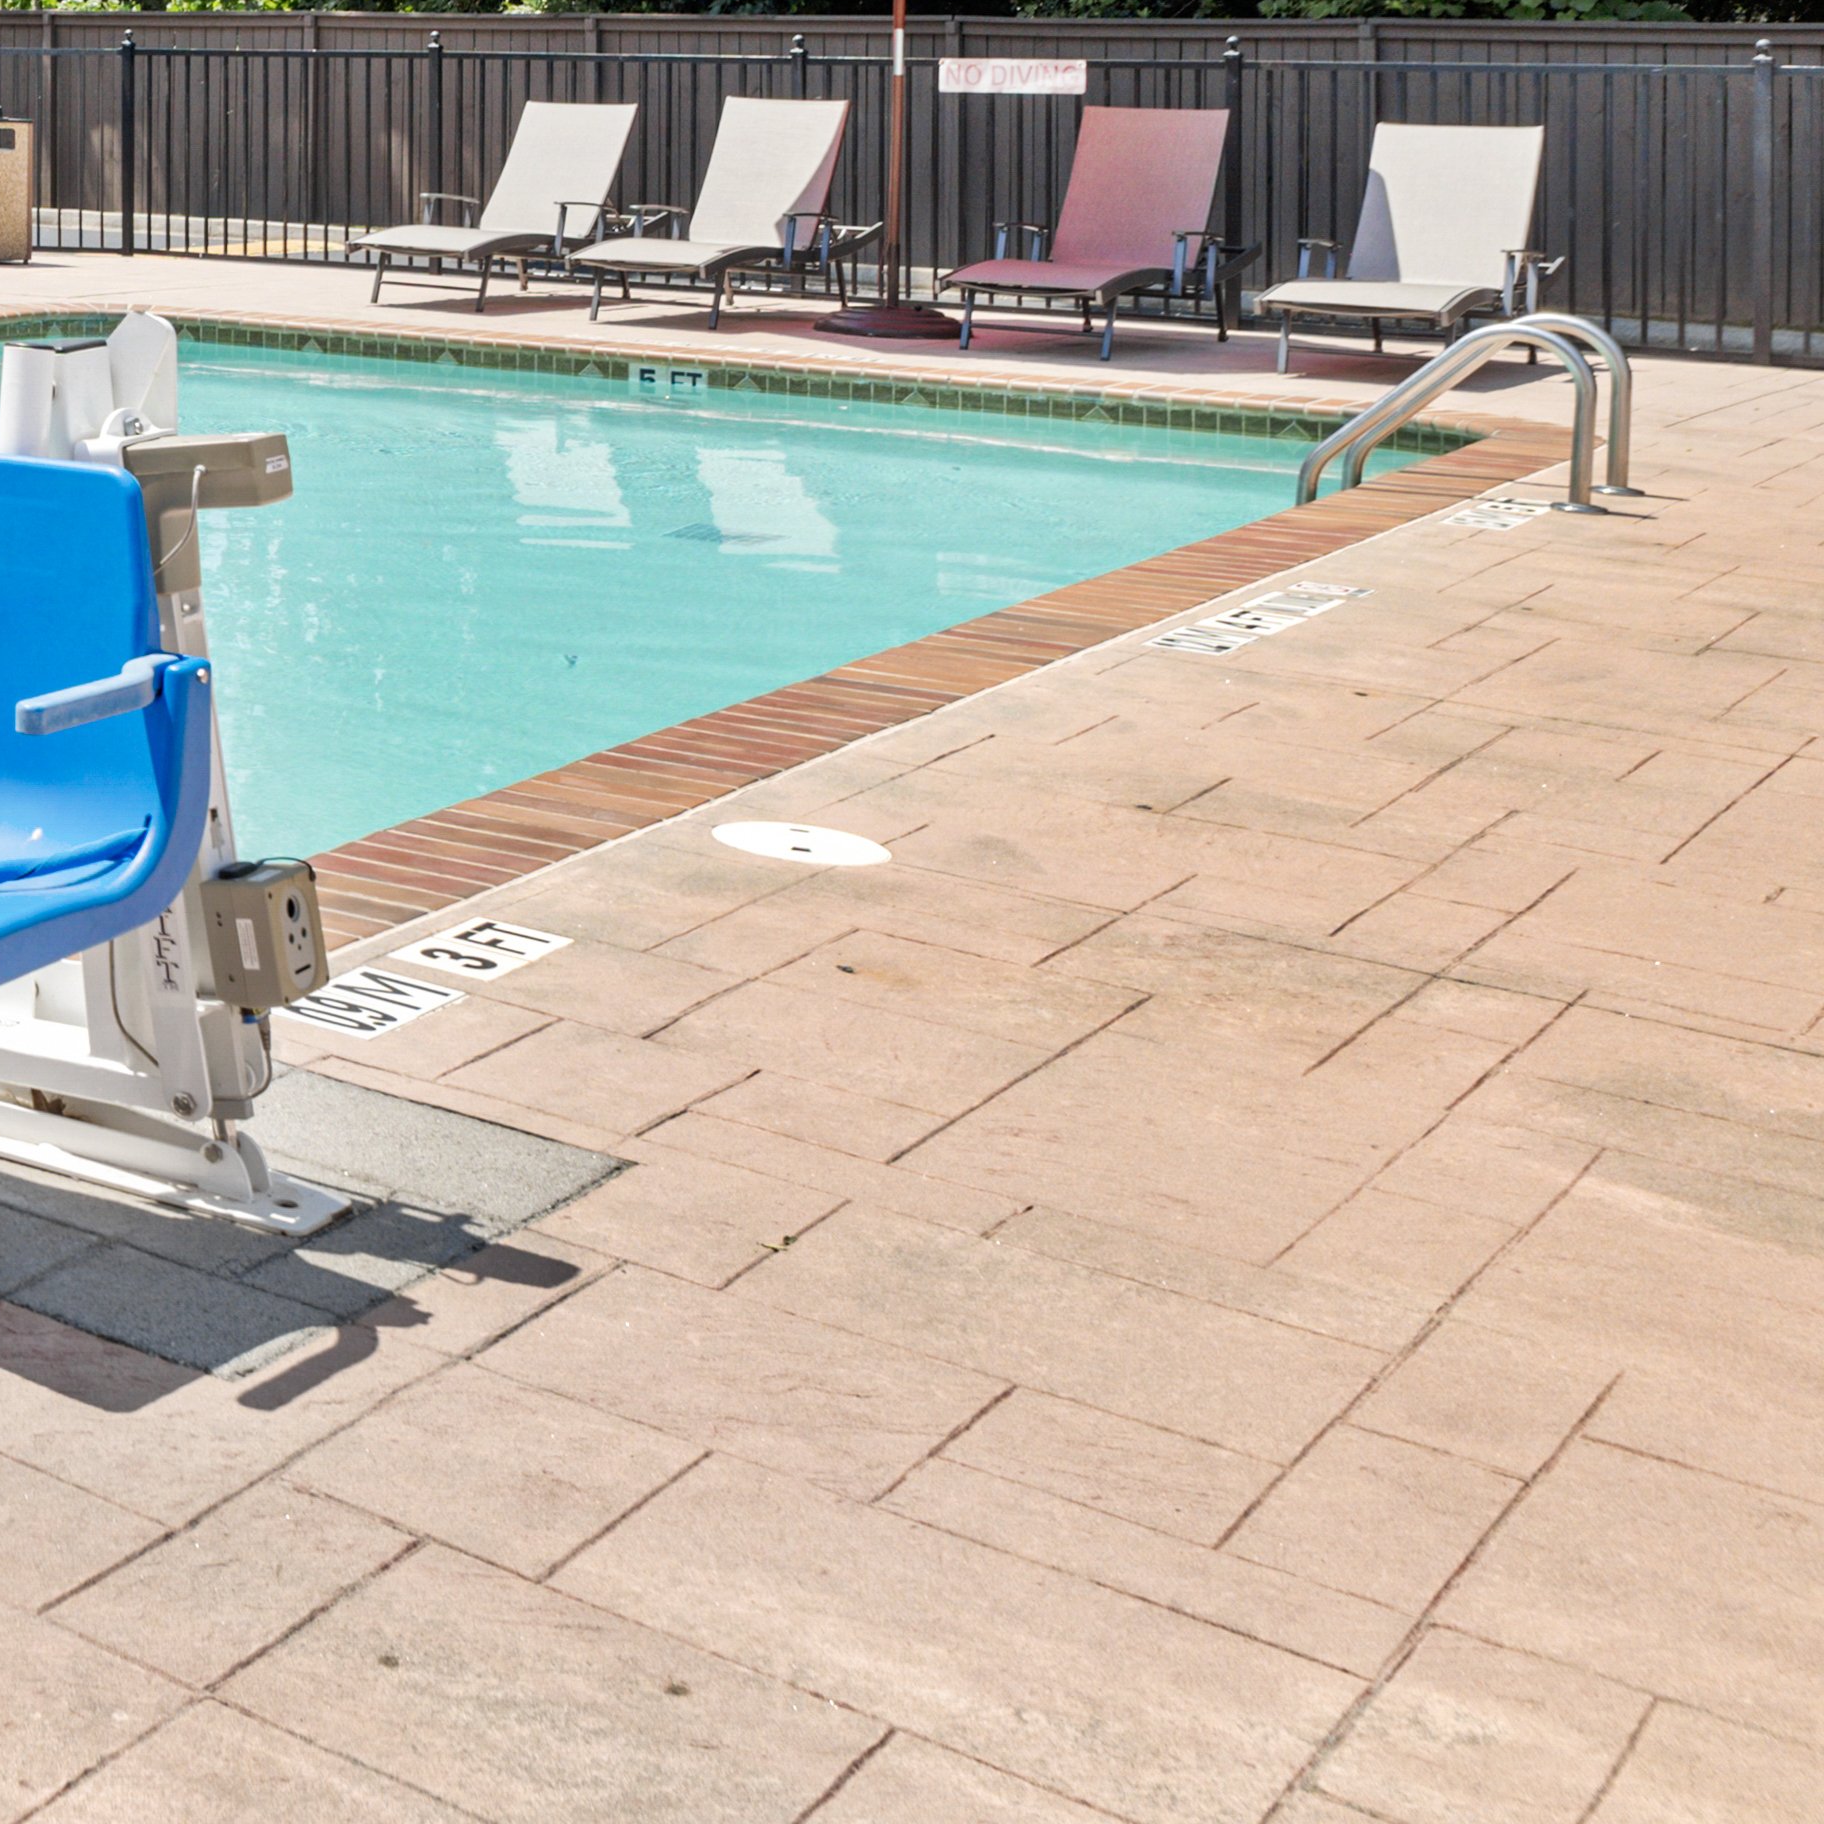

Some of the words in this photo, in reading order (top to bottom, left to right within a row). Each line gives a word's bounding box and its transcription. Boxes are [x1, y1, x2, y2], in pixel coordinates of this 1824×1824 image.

[945, 63, 983, 87] NO
[991, 63, 1080, 87] DIVING
[453, 921, 552, 956] FT
[420, 947, 499, 971] 3
